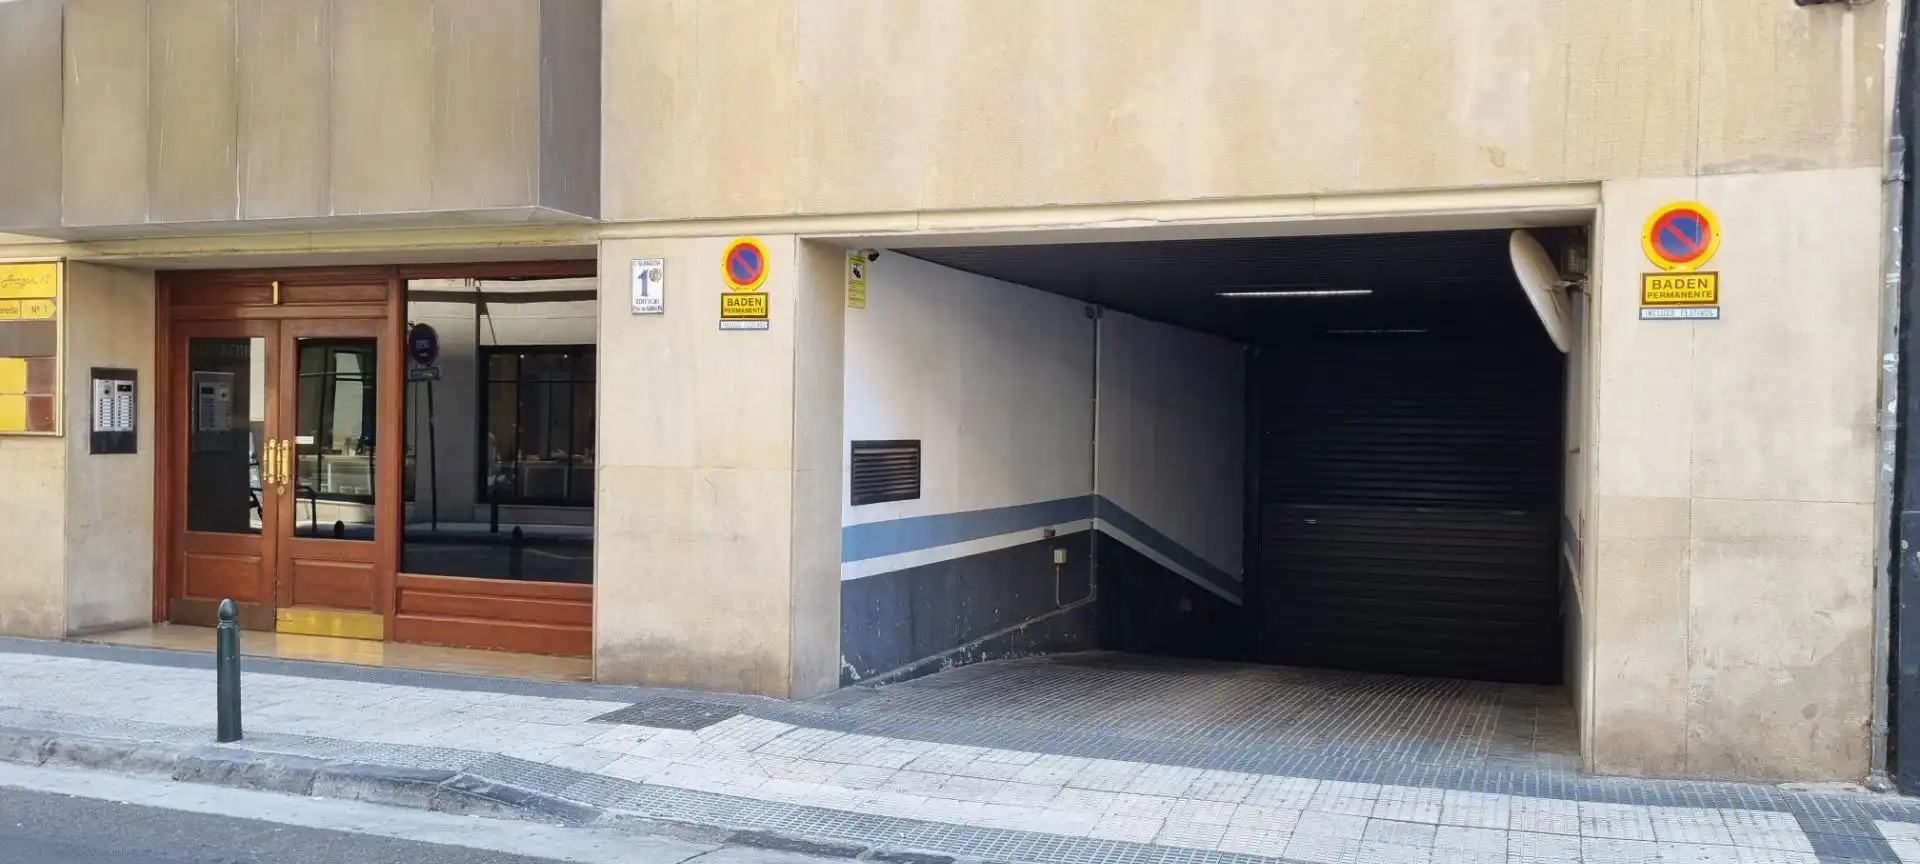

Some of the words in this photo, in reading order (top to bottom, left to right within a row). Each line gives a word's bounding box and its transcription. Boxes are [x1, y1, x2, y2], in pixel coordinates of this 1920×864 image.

[1652, 278, 1708, 290] BADEN
[271, 281, 279, 305] 1
[1647, 290, 1713, 299] PERMANENTE
[727, 297, 762, 307] BADEN
